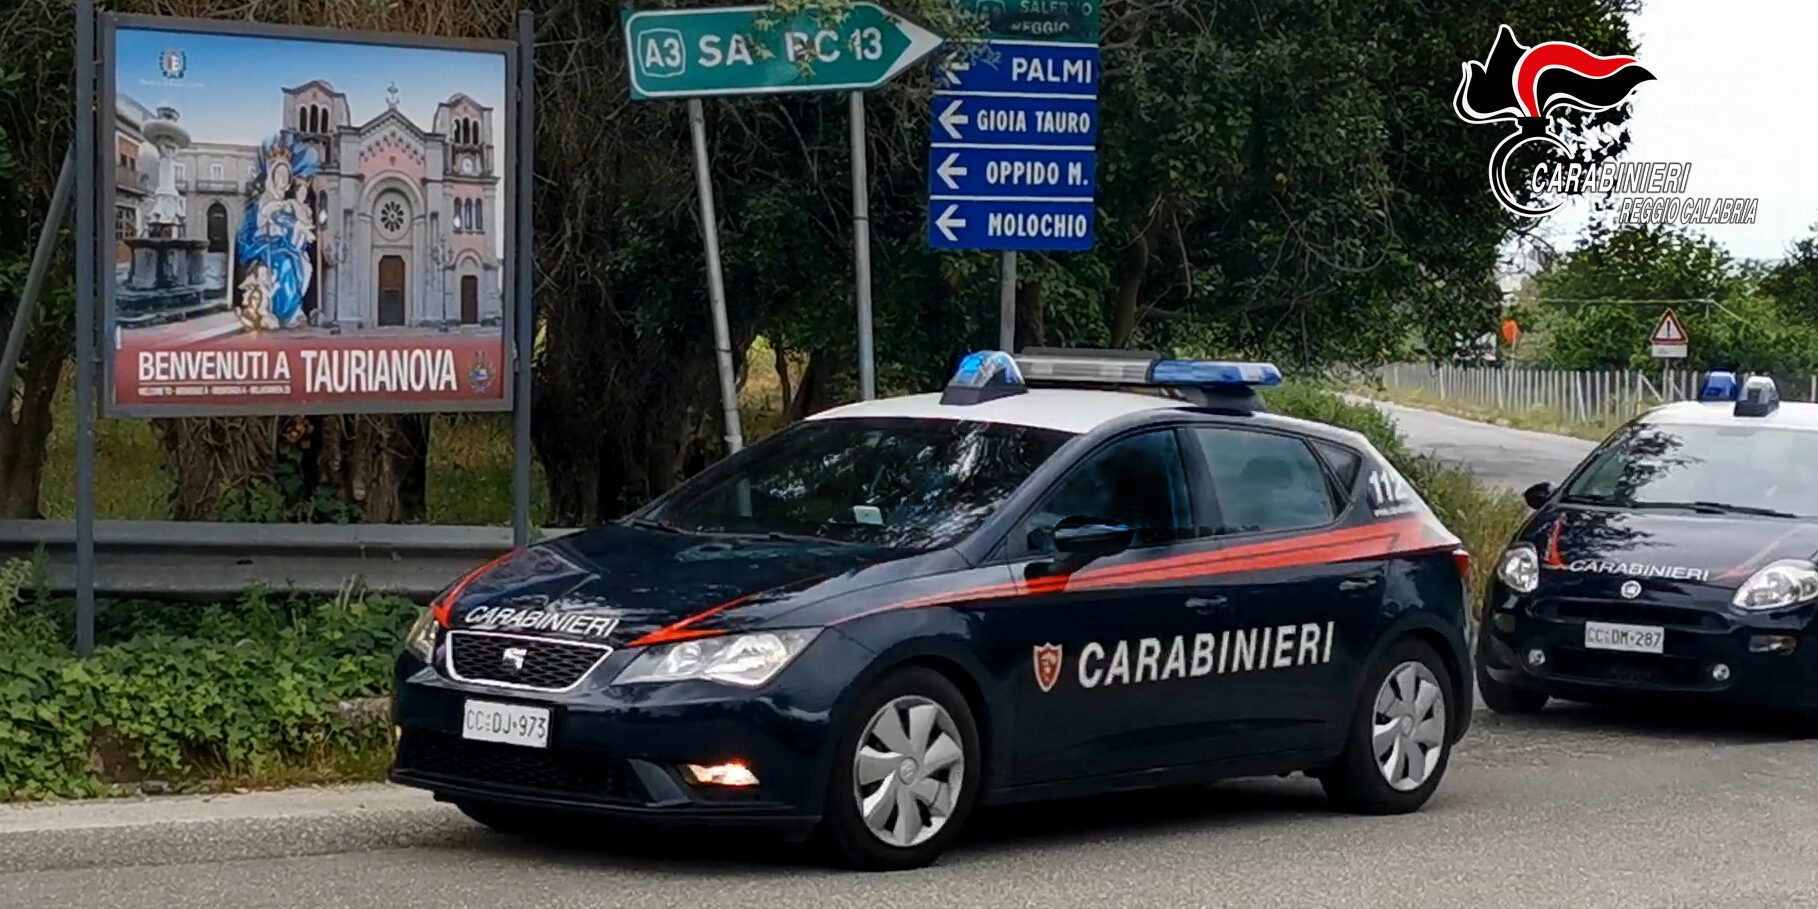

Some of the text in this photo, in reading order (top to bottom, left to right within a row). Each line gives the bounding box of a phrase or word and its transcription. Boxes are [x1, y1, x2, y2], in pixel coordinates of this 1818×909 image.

[1020, 0, 1093, 16] SALERO
[645, 38, 682, 68] A3
[698, 34, 754, 67] SA
[850, 26, 883, 61] 13
[1012, 57, 1092, 84] PALMI
[976, 109, 1091, 133] GIOIA TAURO
[986, 161, 1089, 186] OPPIDO M.
[987, 212, 1087, 238] MOLOCHIO
[138, 349, 458, 393] BENVENUTI A TAURIANOVA
[1369, 470, 1409, 504] 112
[1569, 559, 1710, 582] CARABINIERI
[464, 605, 620, 638] CARABINIERI
[1078, 621, 1336, 689] CARABINIERI
